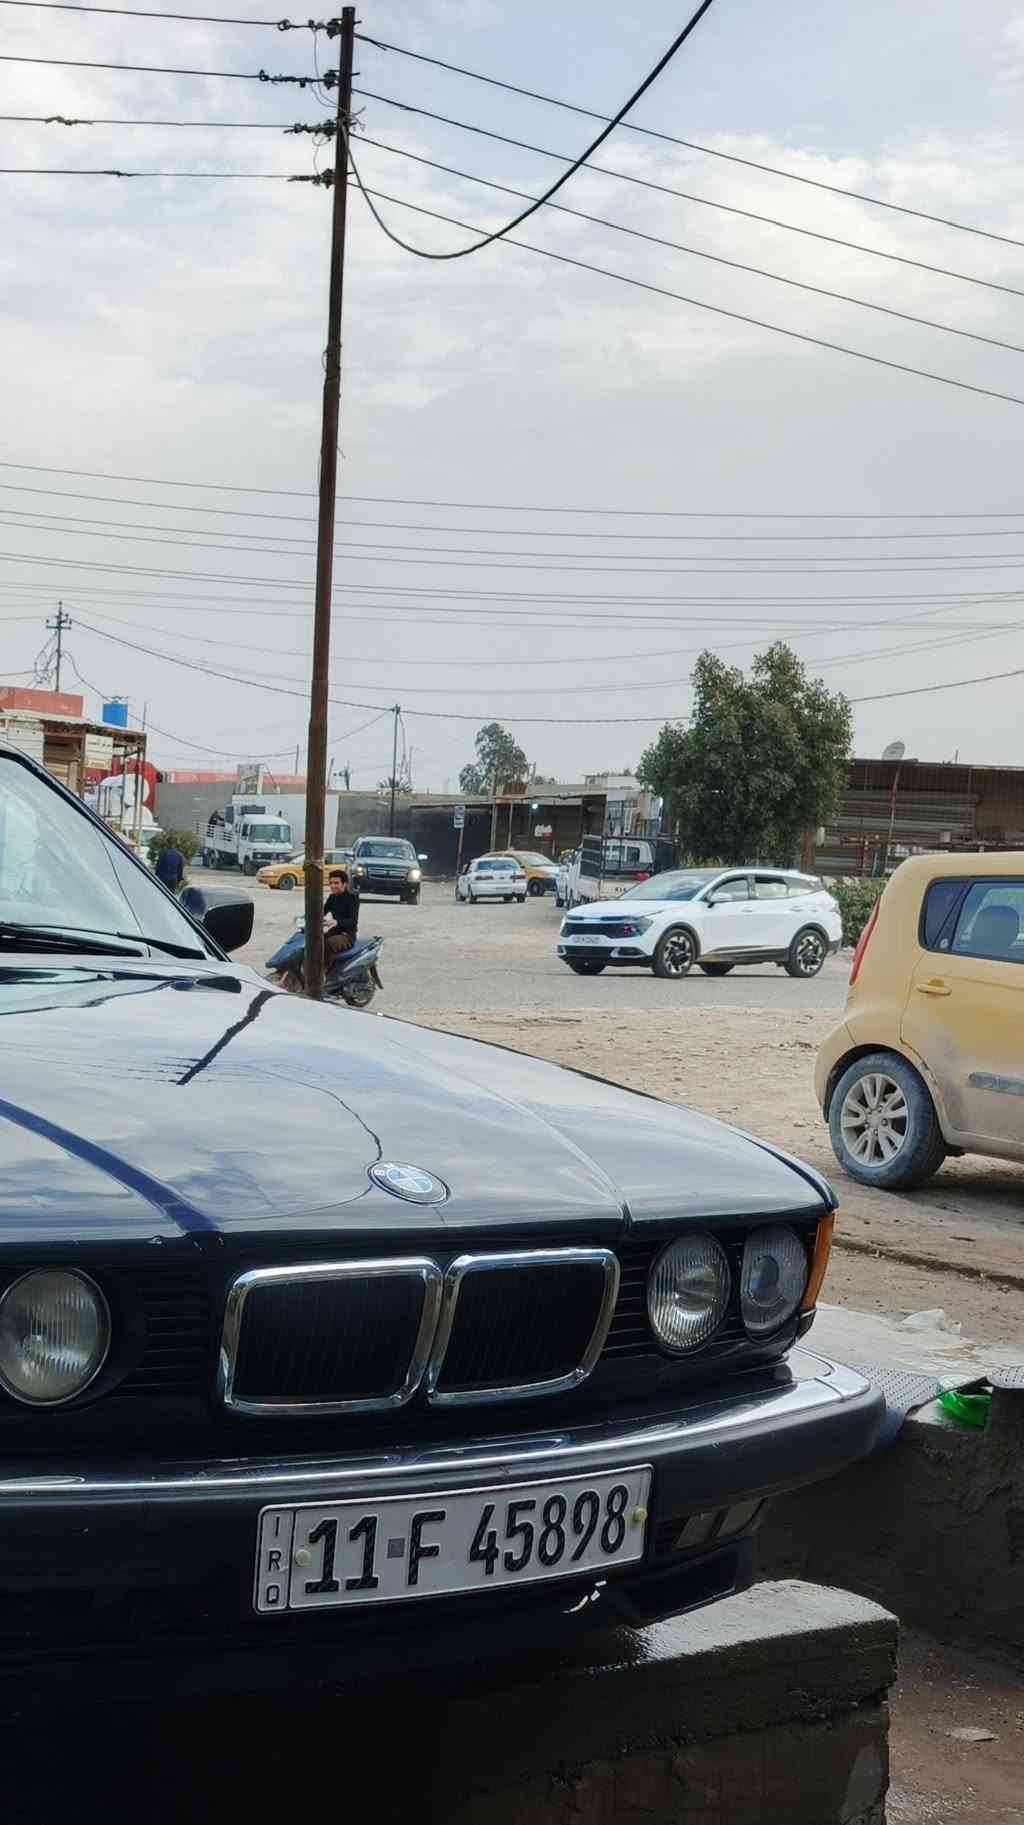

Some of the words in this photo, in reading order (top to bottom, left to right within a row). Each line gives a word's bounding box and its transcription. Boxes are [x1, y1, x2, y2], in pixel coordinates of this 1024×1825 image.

[305, 1515, 379, 1594] 11
[408, 1510, 446, 1586] F
[469, 1484, 629, 1576] 45898
